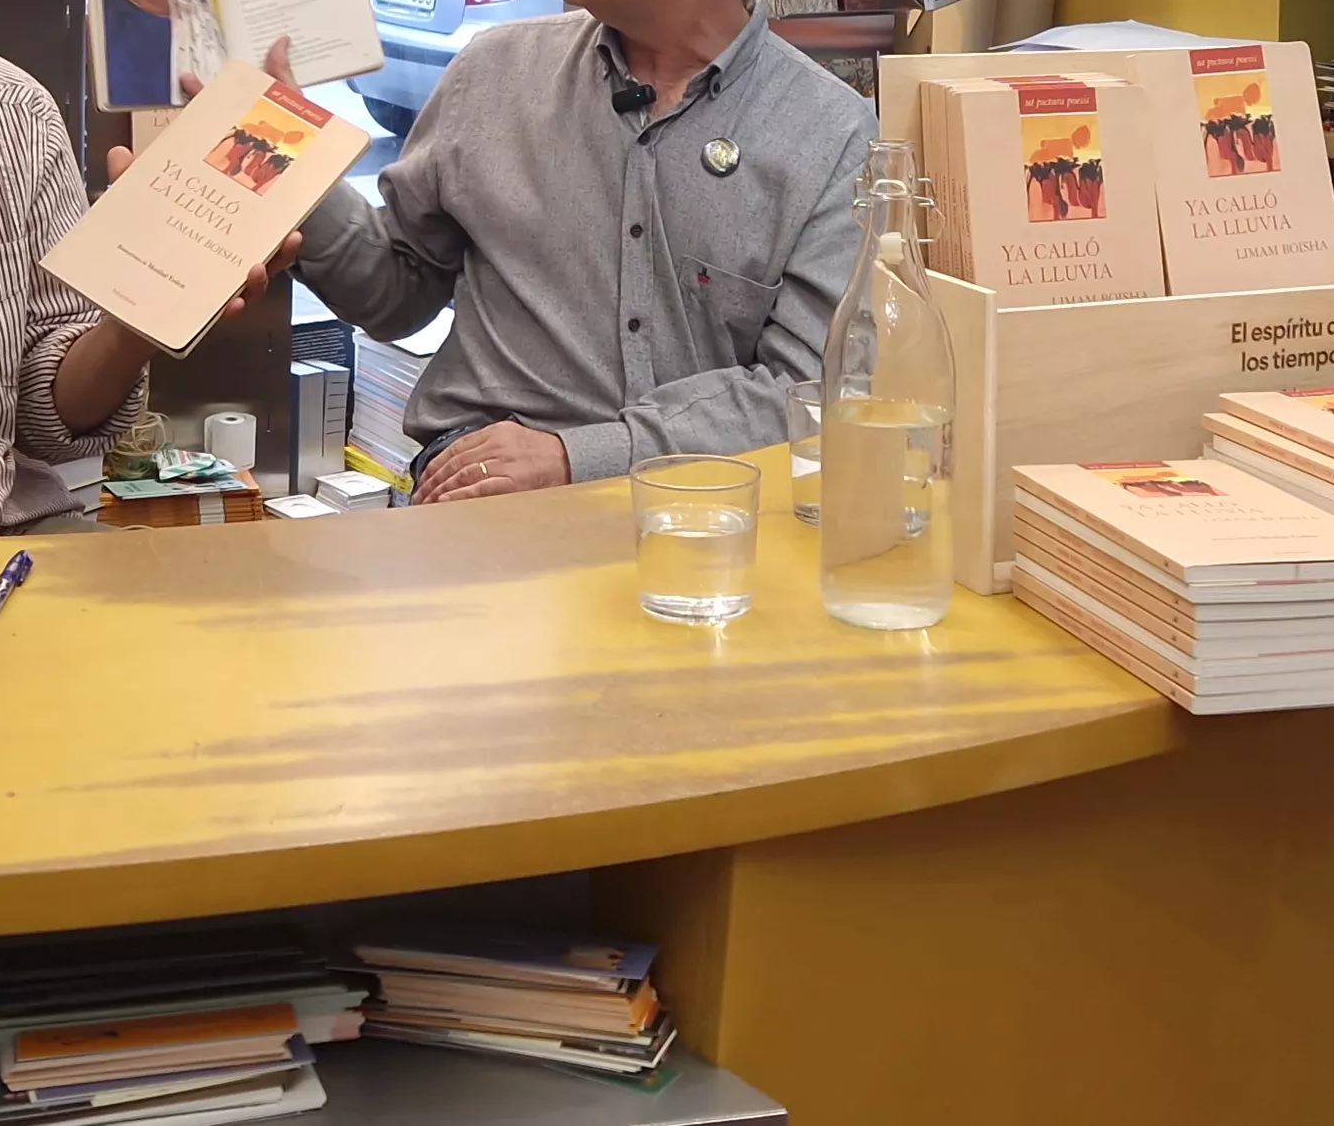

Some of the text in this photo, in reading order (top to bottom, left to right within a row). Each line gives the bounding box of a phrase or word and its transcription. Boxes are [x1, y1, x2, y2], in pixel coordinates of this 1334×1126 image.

[162, 159, 240, 215] YA CALLÓ
[149, 176, 233, 235] LA LLUVIA
[1185, 189, 1278, 217] YA CALLÓ
[1192, 214, 1292, 239] LA LLUVIA
[1002, 236, 1100, 263] YA CALLÓ
[1236, 240, 1329, 260] LIMAM BOISHA
[1008, 263, 1114, 286] LA LLUVIA
[1232, 323, 1247, 344] El
[1251, 317, 1323, 343] espíritu
[1241, 352, 1268, 372] los
